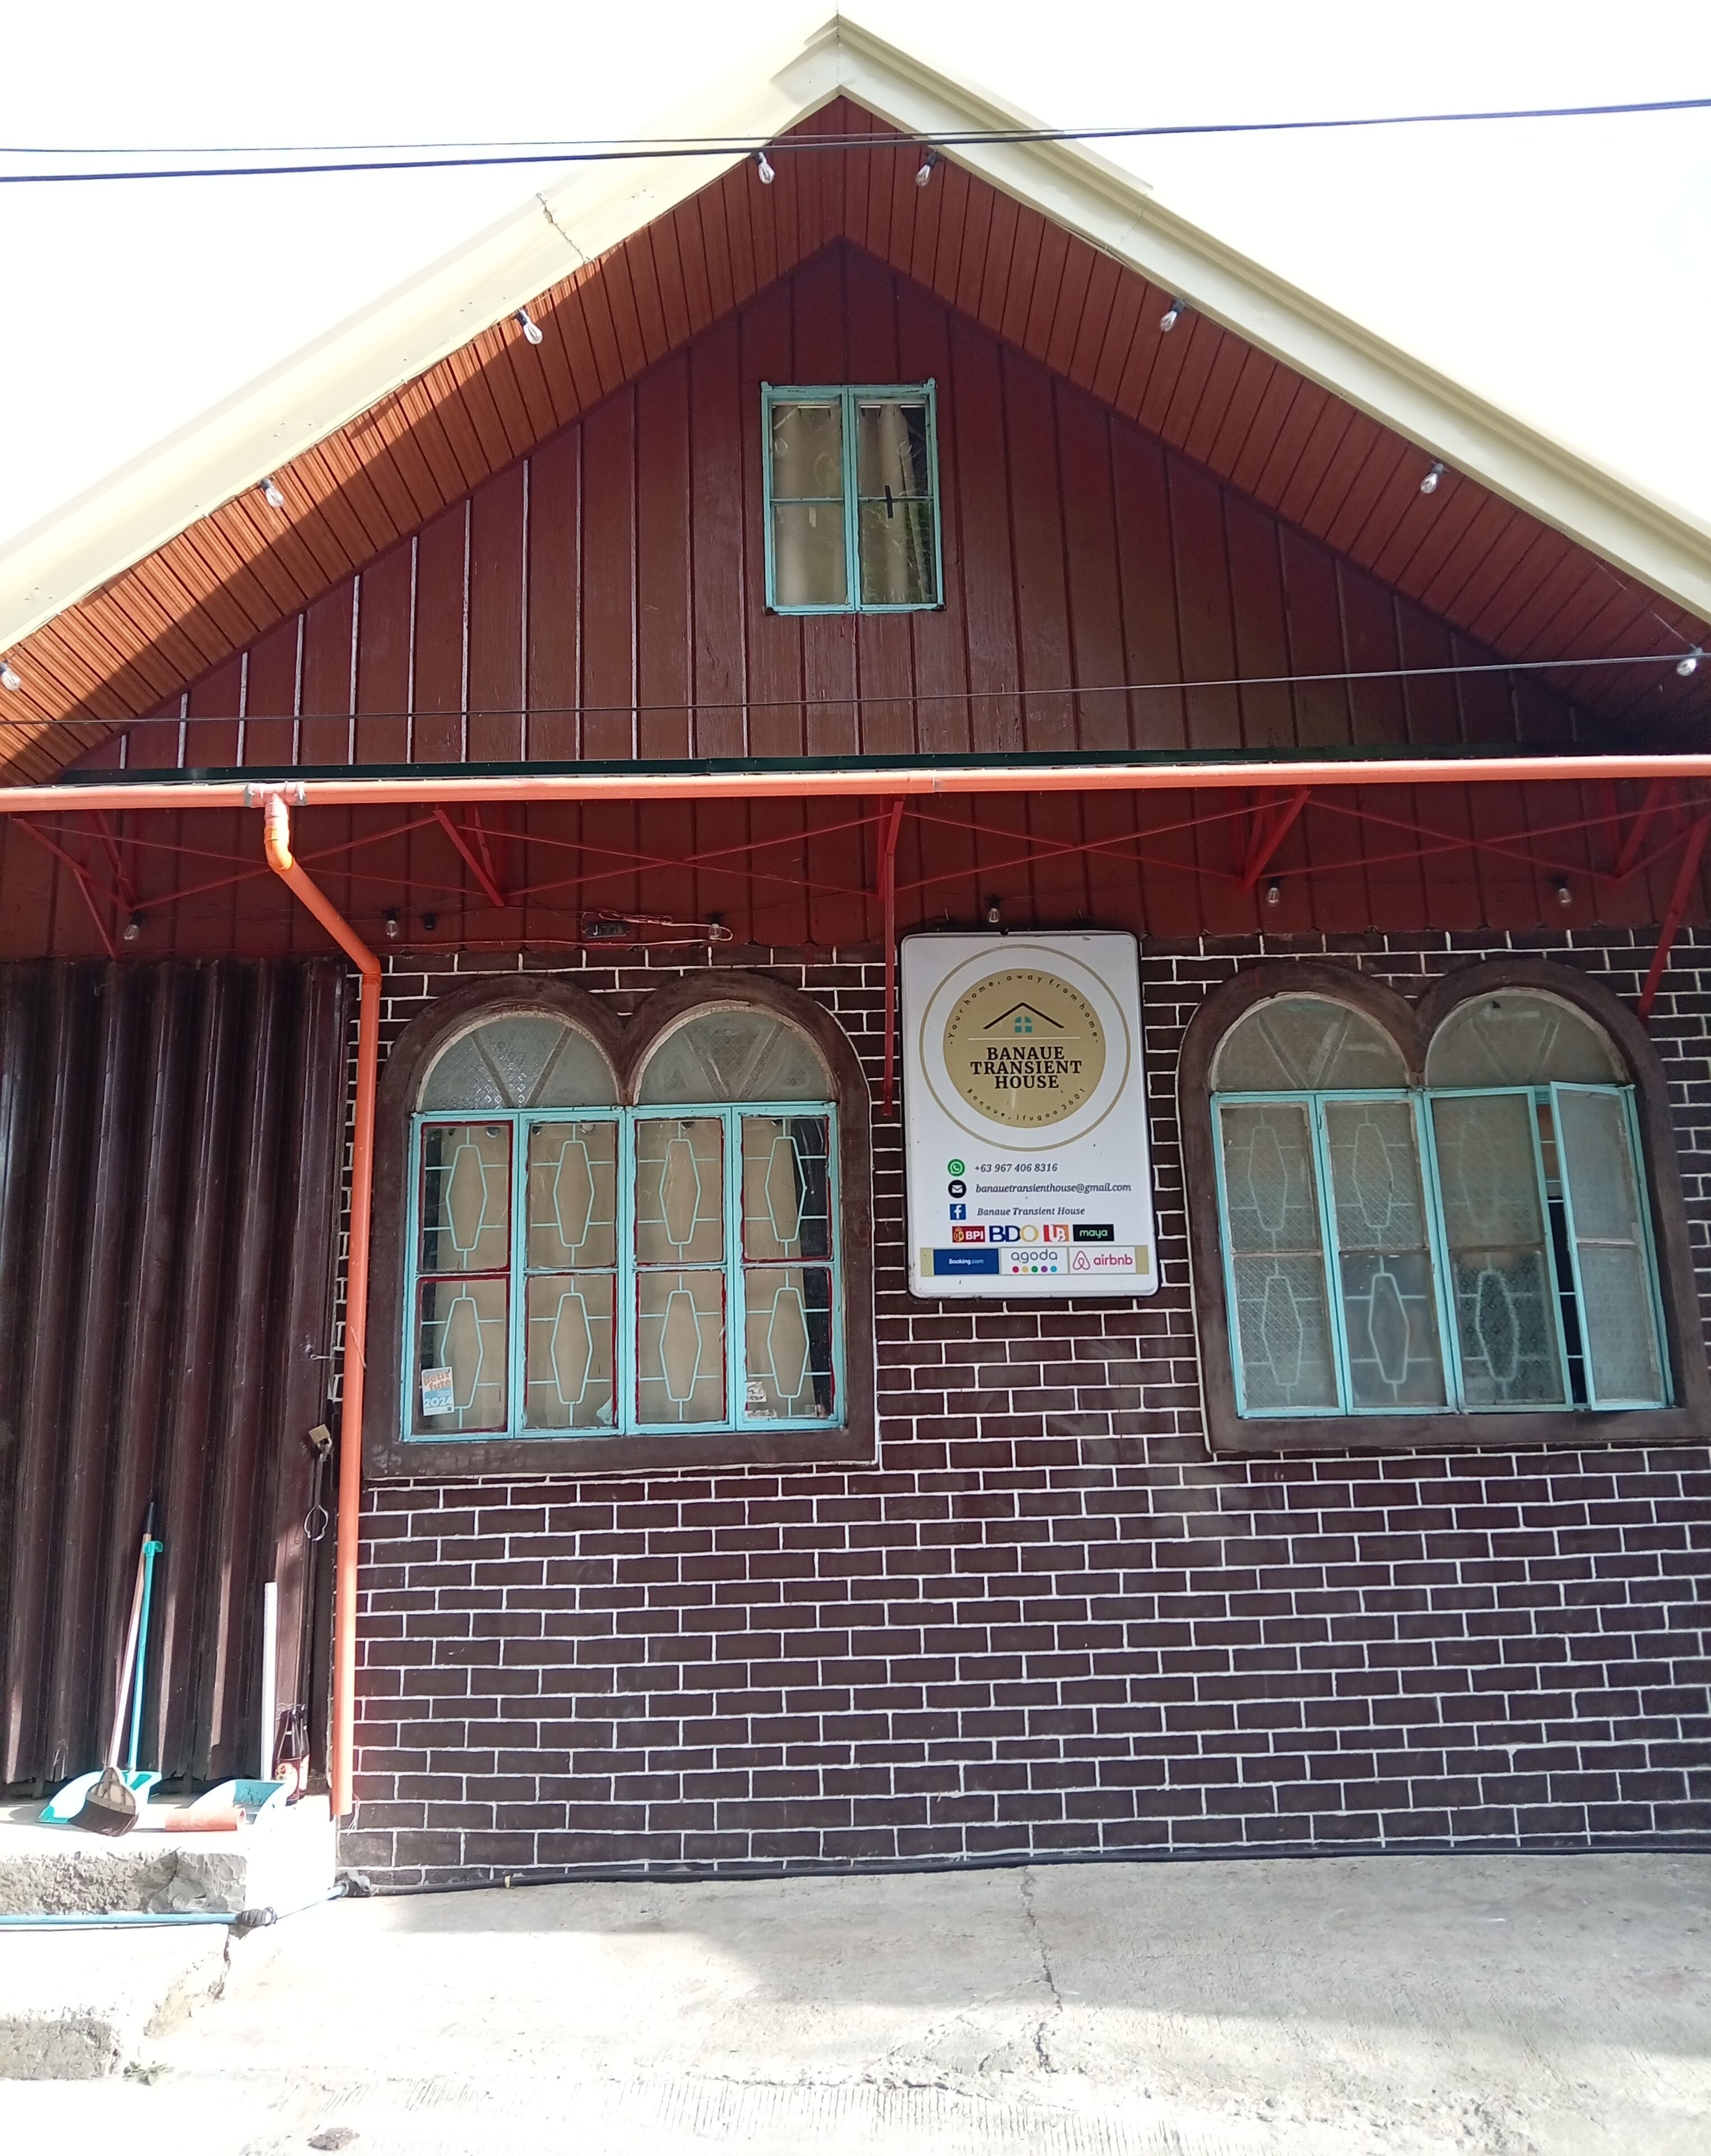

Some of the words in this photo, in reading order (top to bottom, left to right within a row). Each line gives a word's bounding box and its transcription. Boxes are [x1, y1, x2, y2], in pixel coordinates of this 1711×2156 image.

[1007, 975, 1042, 983] away
[1049, 979, 1077, 1001] from
[986, 1046, 1065, 1060] BANAUE
[970, 1060, 1082, 1075] TRANSIENT
[995, 1075, 1059, 1089] HOUSE
[967, 1088, 1010, 1120] Banaue,
[1061, 1088, 1085, 1110] 3601
[975, 1164, 992, 1172] +63
[994, 1164, 1012, 1172] 967
[1014, 1164, 1032, 1172] 406
[1034, 1163, 1058, 1172] 8316
[975, 1182, 1132, 1194] banauetransienthouse@gmail.com
[977, 1208, 1010, 1216] Banaue
[1013, 1207, 1055, 1216] Transient
[1058, 1207, 1085, 1215] House
[965, 1230, 984, 1240] BPI
[989, 1225, 1039, 1243] BDO
[1079, 1229, 1108, 1239] maya
[1010, 1249, 1058, 1264] agoda
[1094, 1254, 1133, 1266] airbnb
